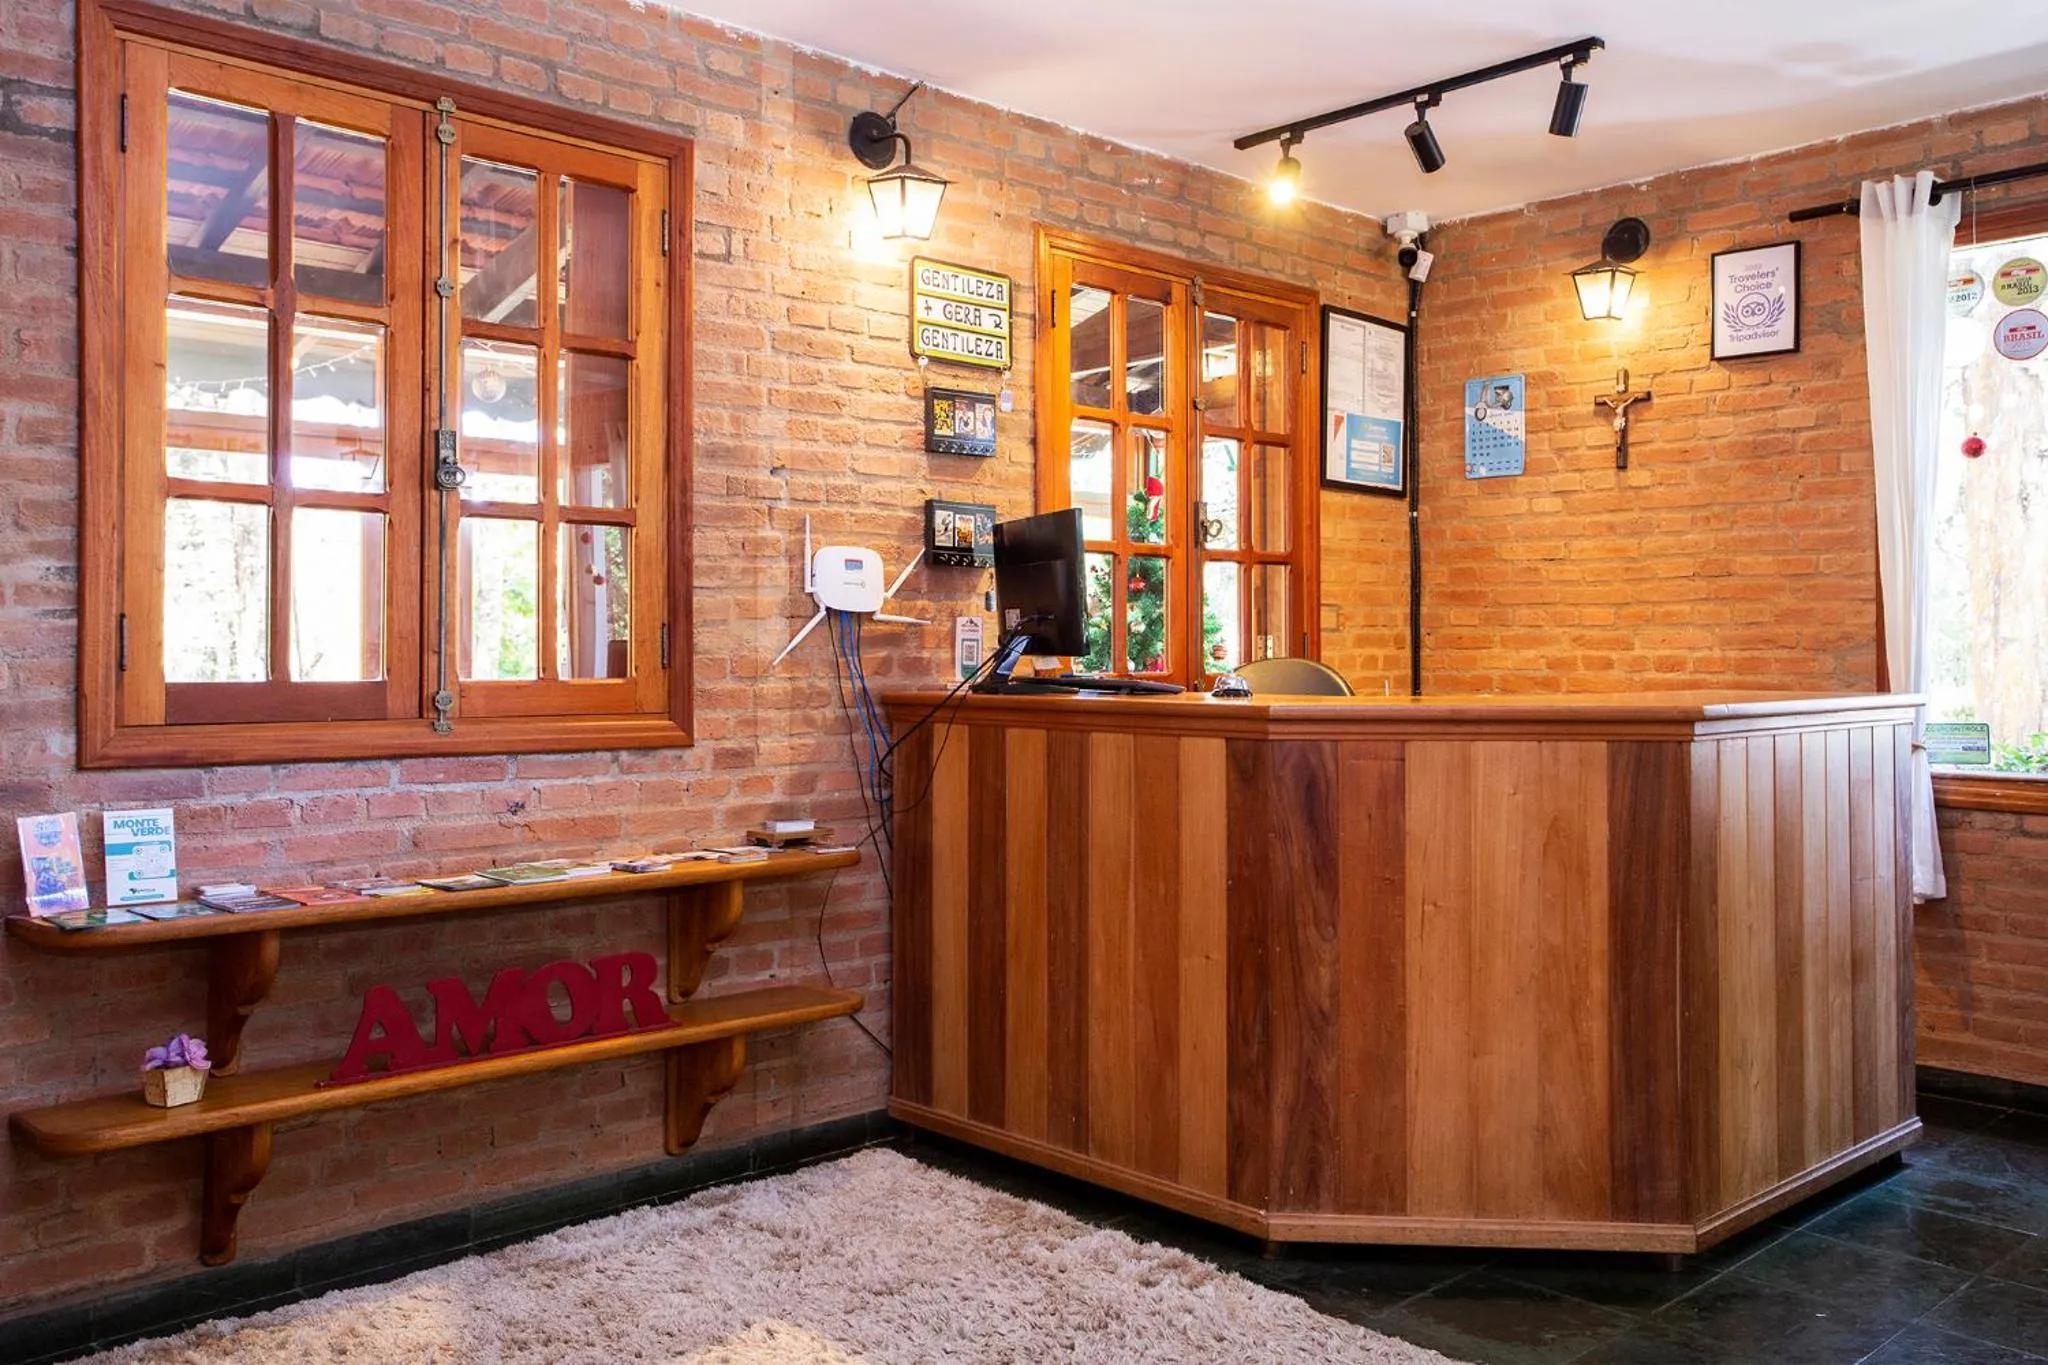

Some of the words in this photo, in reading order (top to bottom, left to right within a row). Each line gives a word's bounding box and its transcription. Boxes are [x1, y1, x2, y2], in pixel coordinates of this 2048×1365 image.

[921, 268, 1004, 302] GENTILEZA
[1734, 281, 1773, 294] Choice
[2017, 285, 2040, 295] 2013
[942, 303, 982, 327] GERA
[920, 327, 1003, 359] GENTILEZA
[2003, 330, 2045, 343] BRASIL
[113, 818, 160, 829] MONTE
[130, 826, 172, 837] VERDE
[328, 951, 672, 1081] AMOR
